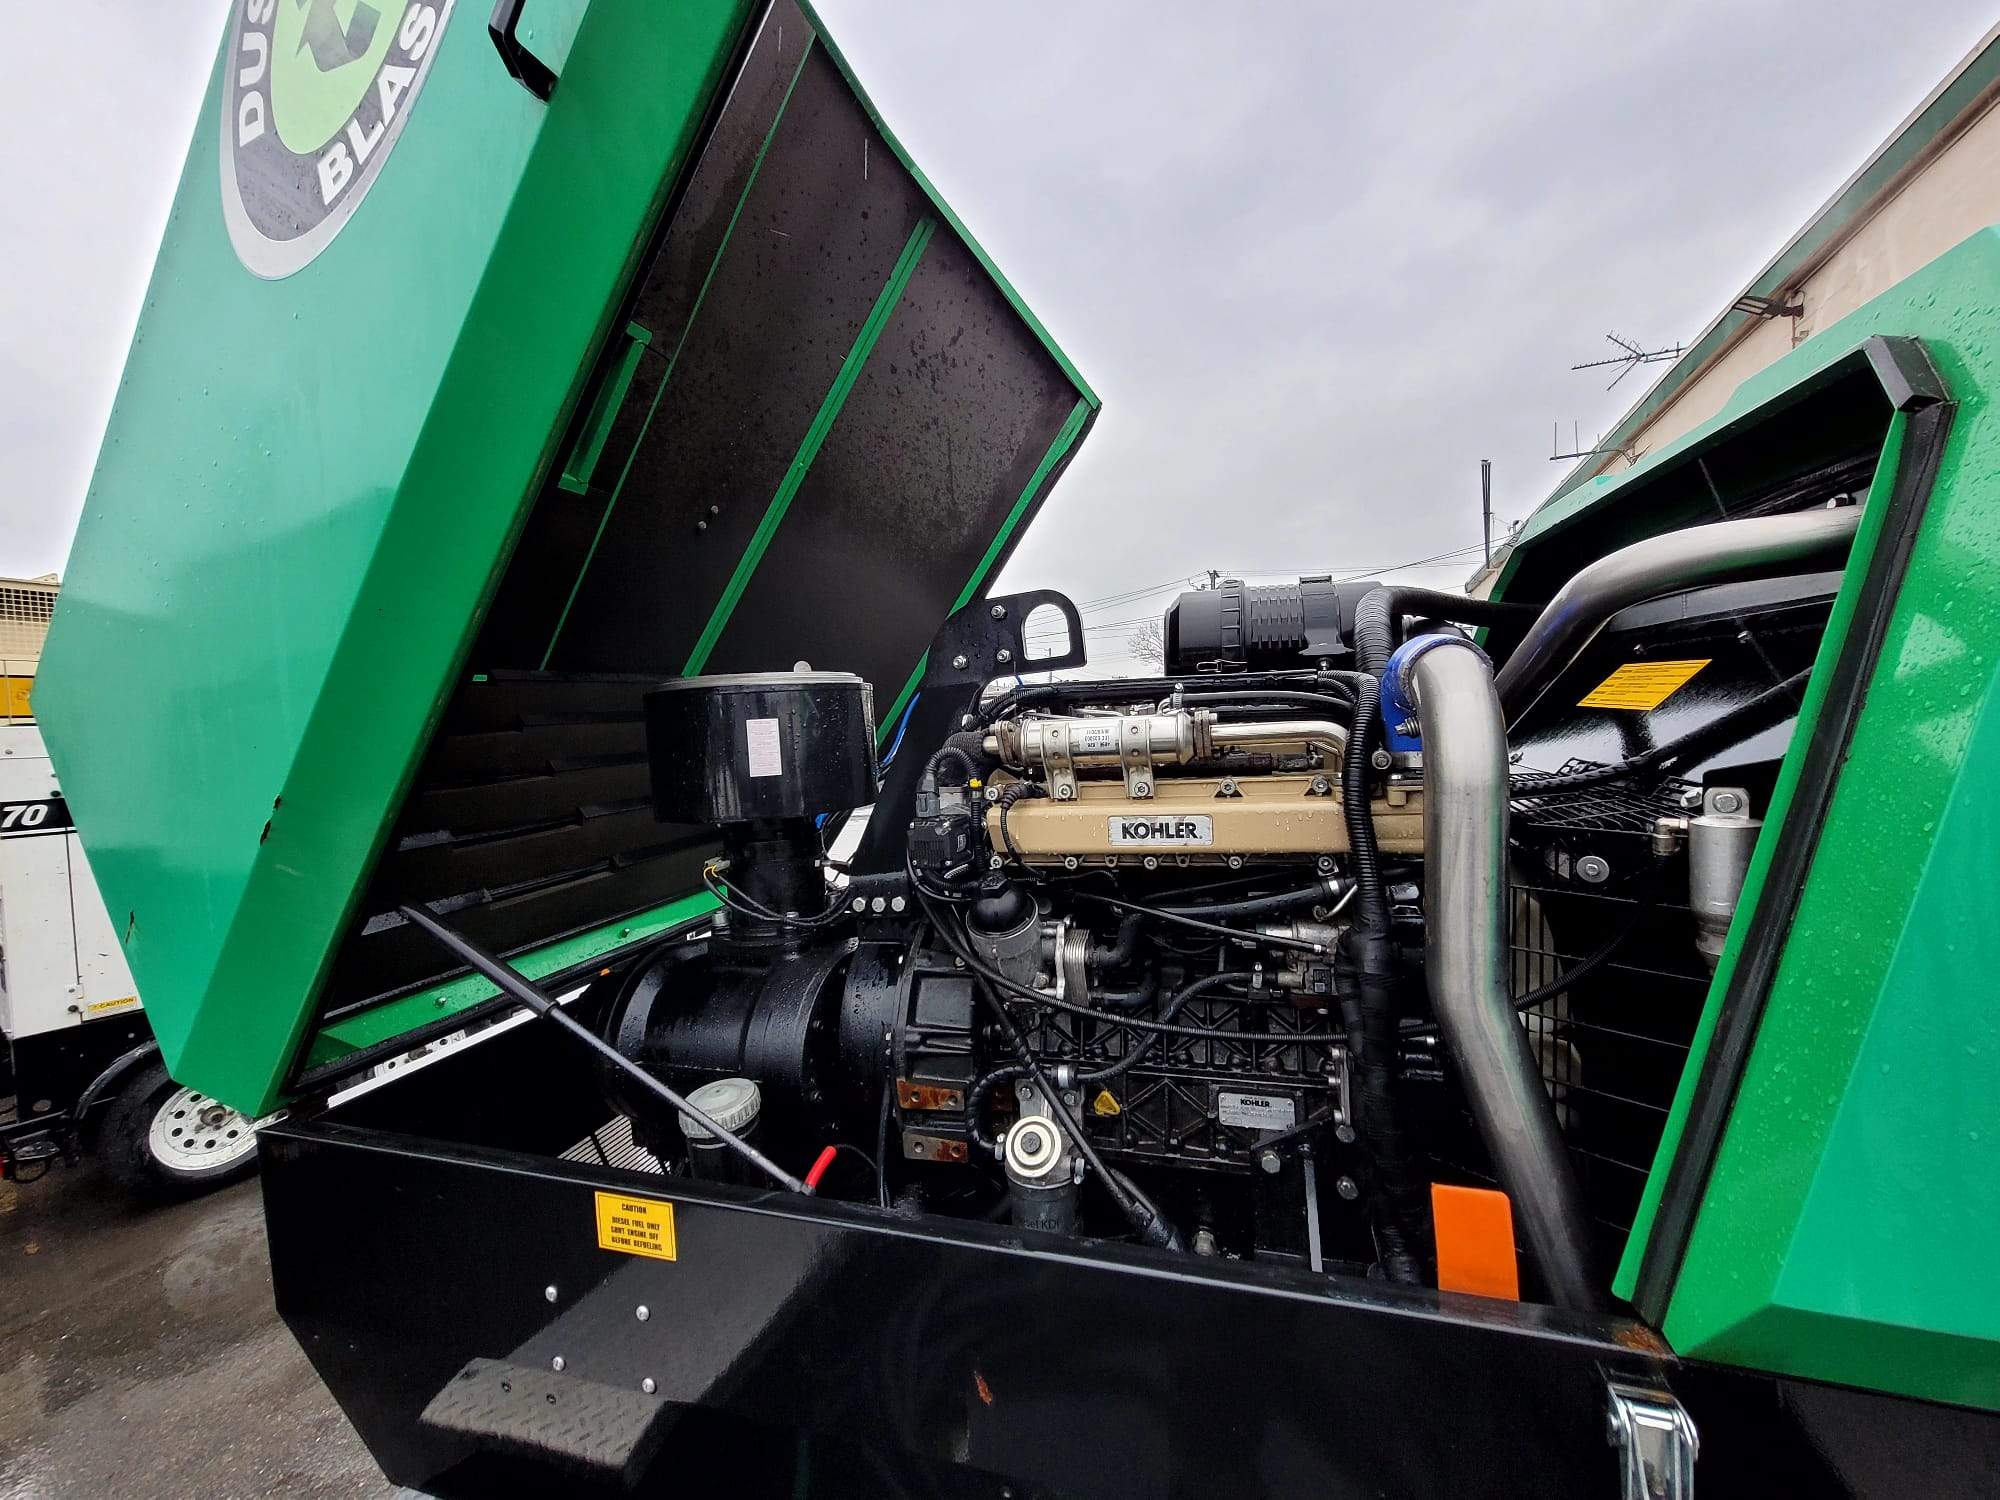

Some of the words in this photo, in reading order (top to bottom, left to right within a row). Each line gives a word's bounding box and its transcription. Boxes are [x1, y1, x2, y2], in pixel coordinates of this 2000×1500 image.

[1, 804, 48, 828] 70
[1121, 822, 1199, 839] KOHLER
[1240, 1099, 1271, 1107] KOHLER
[621, 1203, 647, 1214] CAUTION
[611, 1216, 630, 1225] DIESEL
[632, 1219, 644, 1228] FUEL
[646, 1222, 660, 1230] ONLY
[610, 1226, 625, 1234] SHUT
[627, 1228, 646, 1238] ENGINE
[649, 1232, 658, 1240] OFF
[611, 1236, 631, 1245] BEFORE
